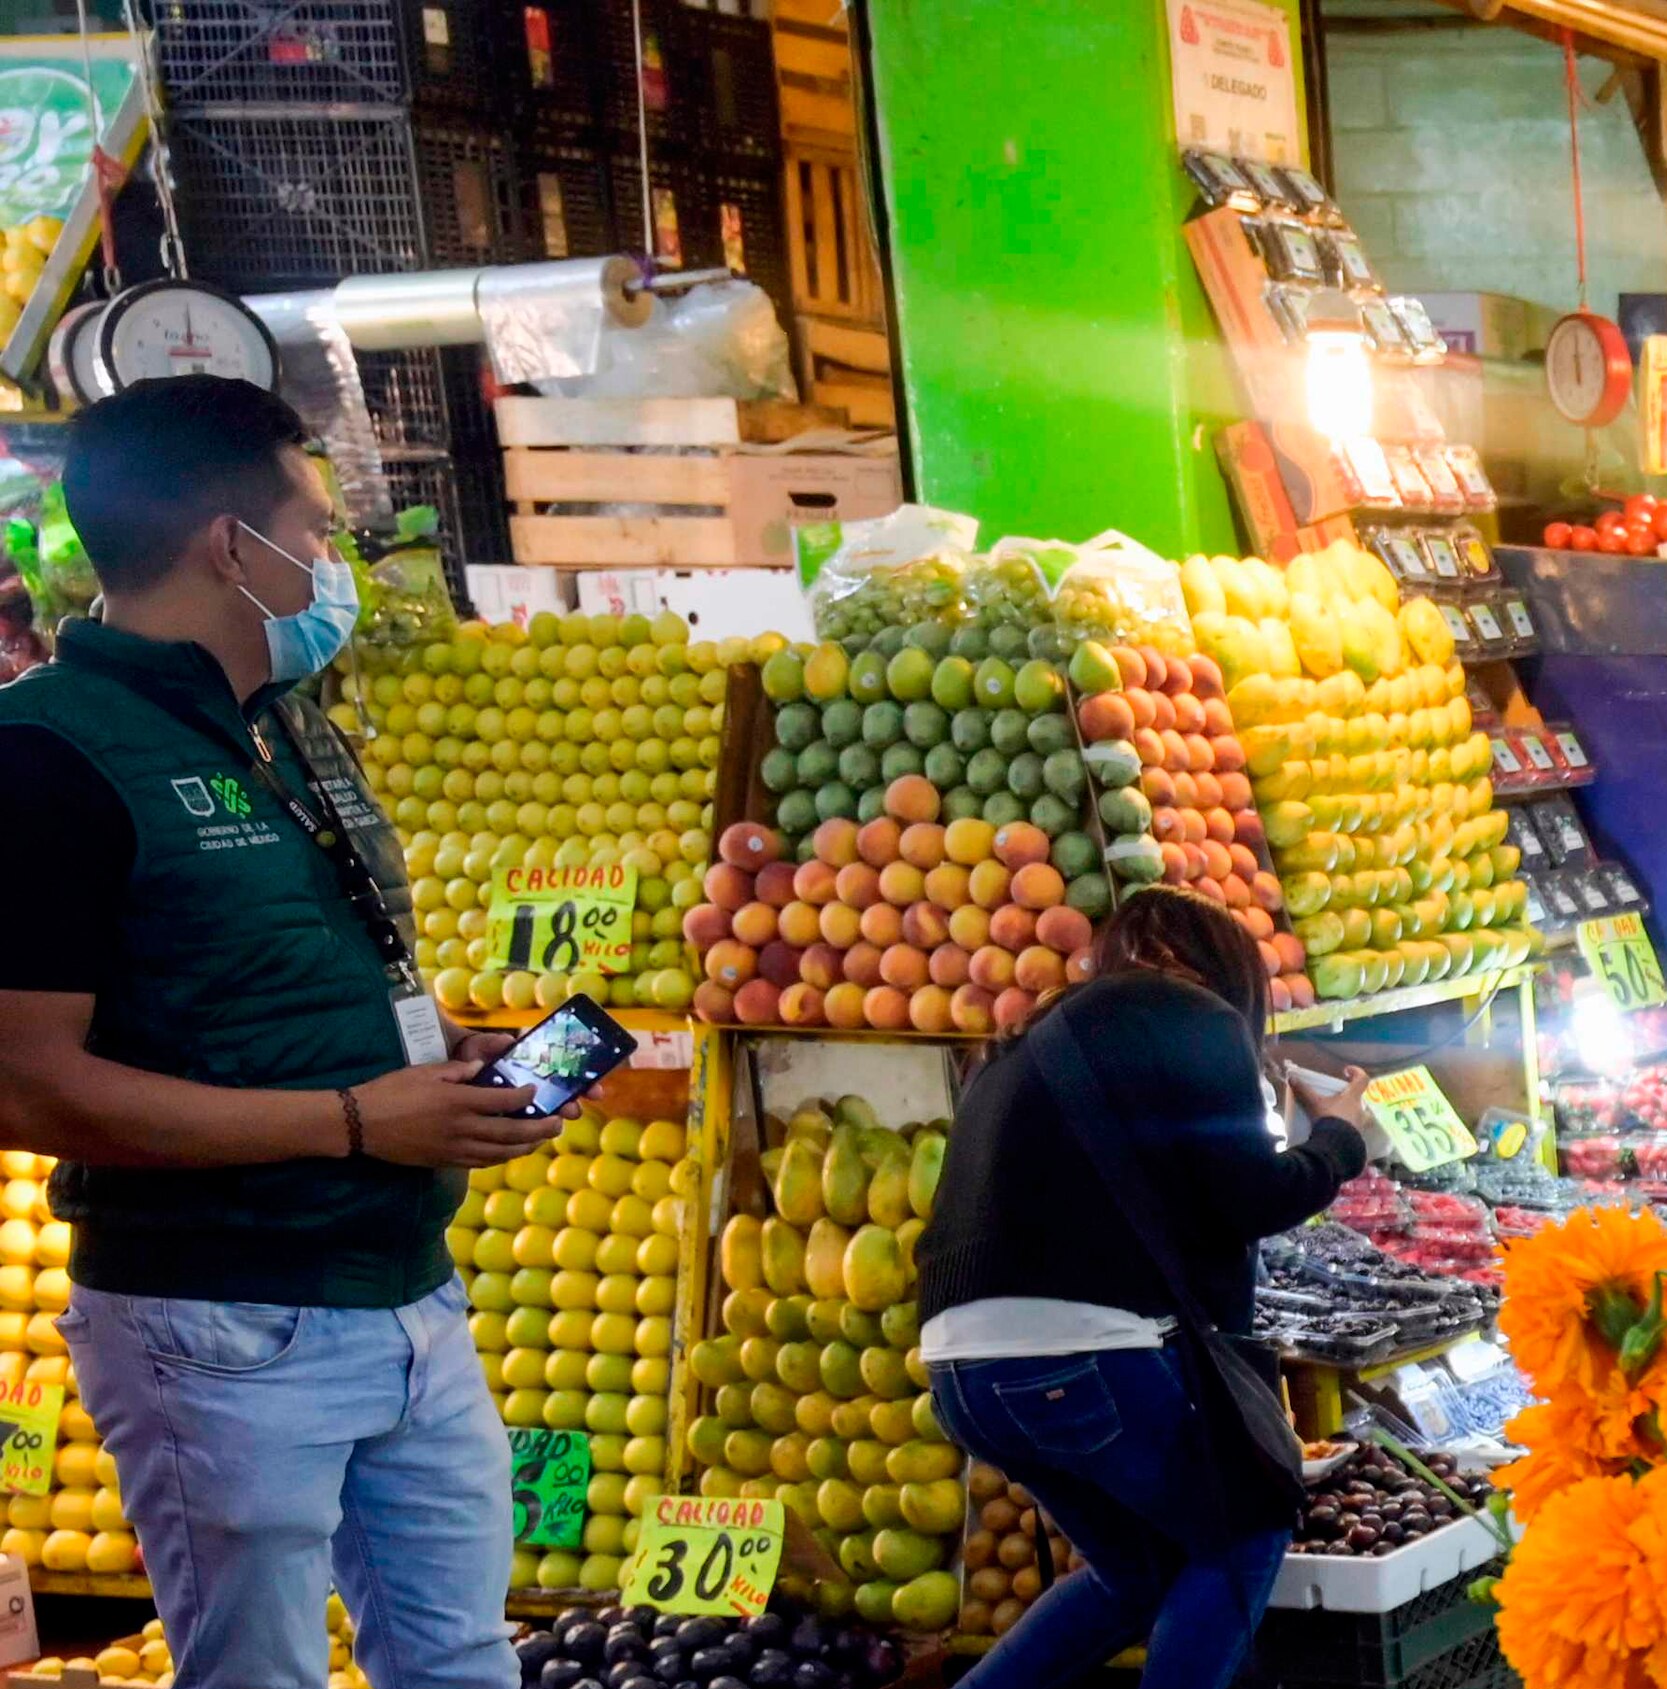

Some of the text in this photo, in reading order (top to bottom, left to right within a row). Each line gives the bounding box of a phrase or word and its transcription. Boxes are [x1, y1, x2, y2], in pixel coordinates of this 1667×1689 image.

[197, 825, 240, 837] GOBIERNO
[255, 821, 270, 831] LA
[200, 838, 234, 850] CIUDAD
[248, 832, 280, 845] MÉXICO
[506, 864, 624, 893] CALIDAD
[509, 896, 618, 973] 18 00
[1598, 943, 1649, 1006] 50
[1395, 1106, 1455, 1161] 35
[656, 1496, 765, 1528] CALIDAD
[647, 1531, 771, 1602] 30 00
